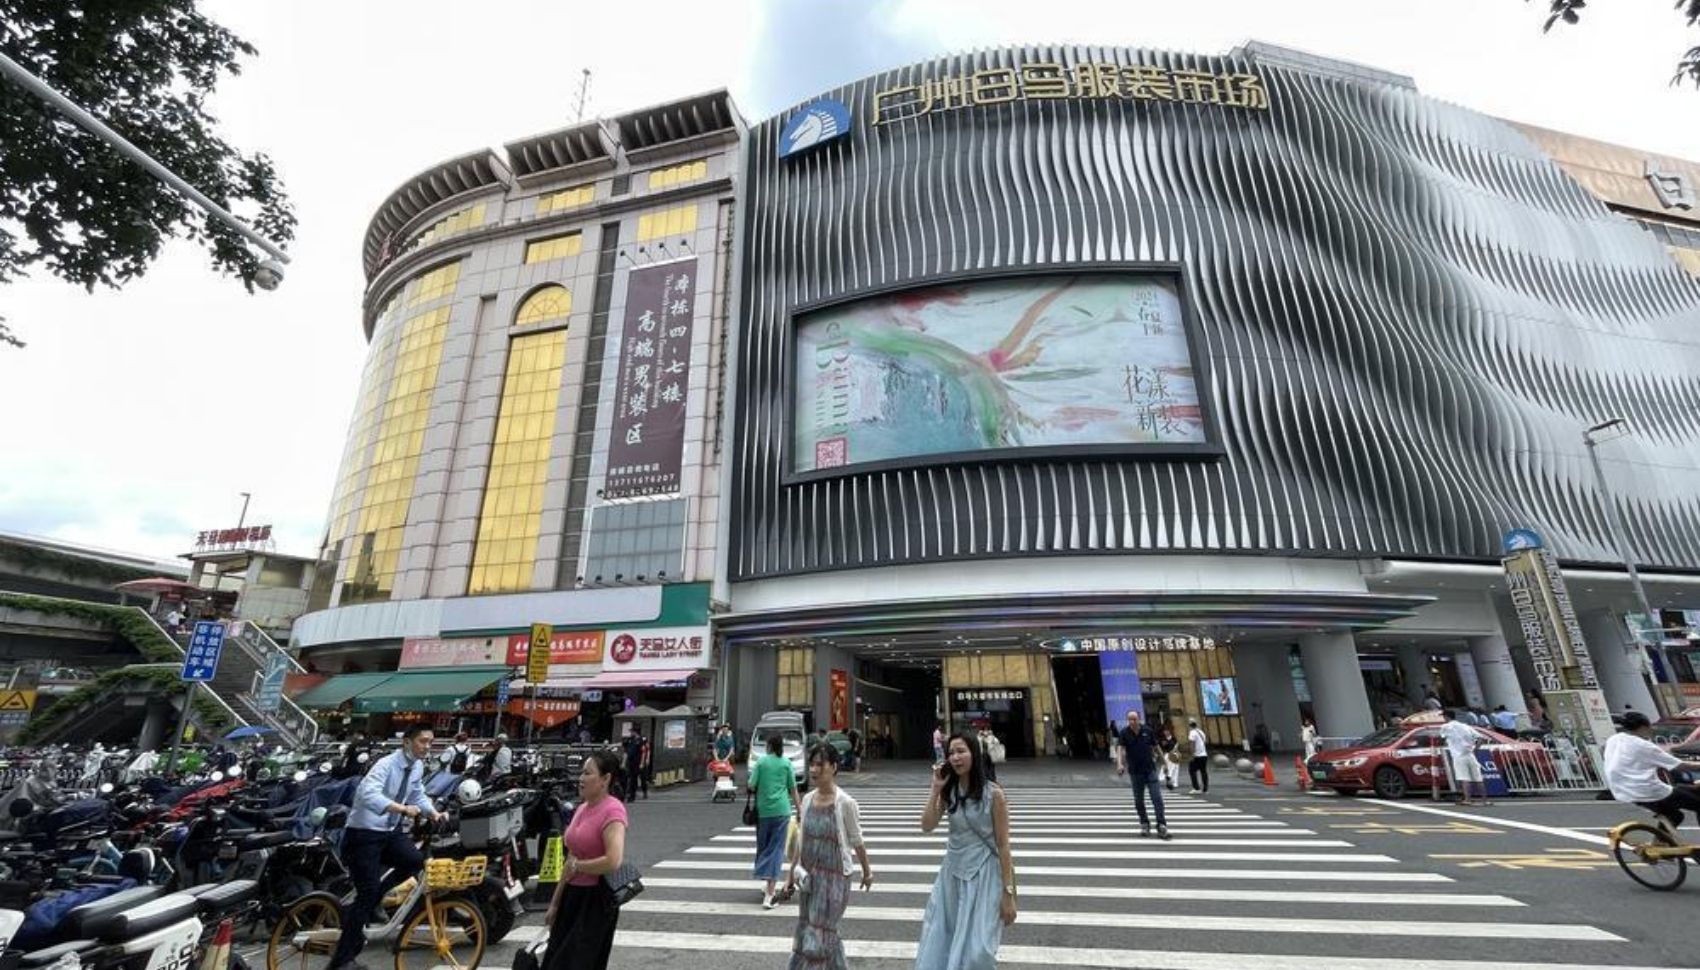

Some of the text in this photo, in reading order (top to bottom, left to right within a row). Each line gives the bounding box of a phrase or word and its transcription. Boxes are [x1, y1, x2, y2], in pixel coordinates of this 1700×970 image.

[871, 61, 1269, 126] 广州白马服装市场
[640, 636, 703, 651] 天马女人街
[1081, 638, 1215, 651] 中国原创设计品牌基地
